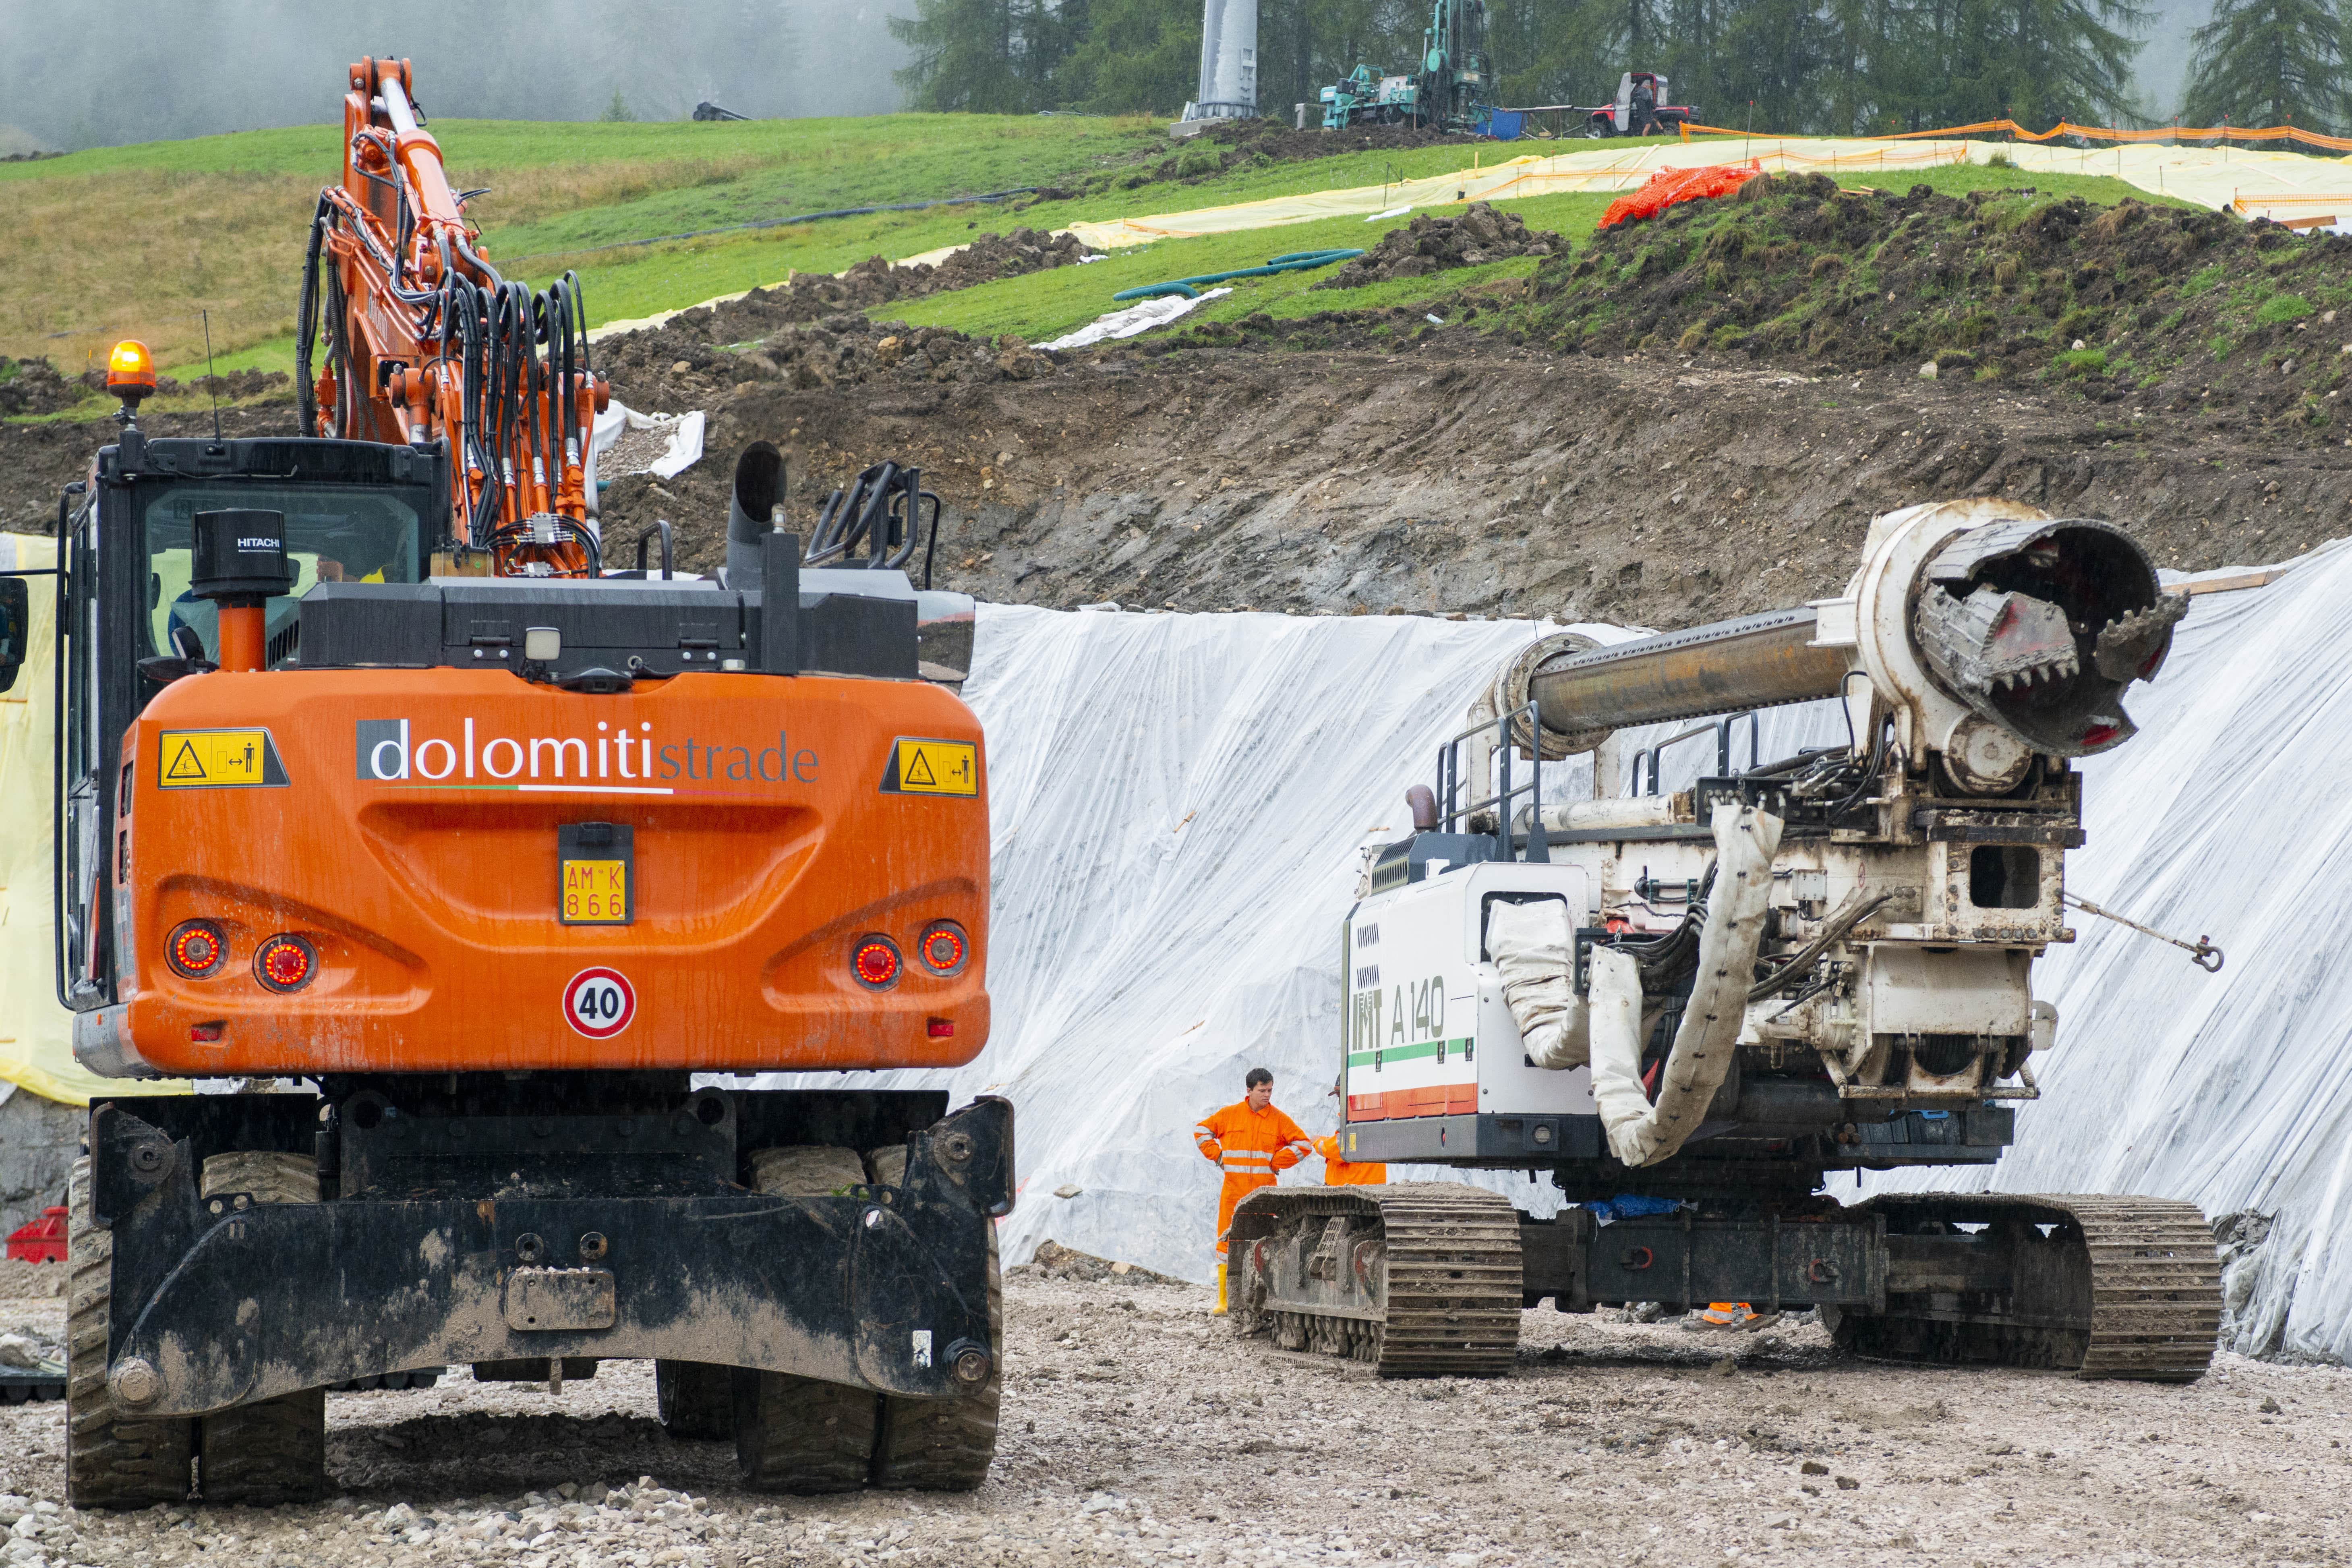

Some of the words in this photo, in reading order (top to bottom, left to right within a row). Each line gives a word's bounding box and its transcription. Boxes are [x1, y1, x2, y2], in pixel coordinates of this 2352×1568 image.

[237, 538, 280, 547] HITACHI
[567, 866, 592, 889] AM
[610, 866, 621, 889] K
[567, 893, 621, 916] 866
[579, 987, 619, 1019] 40
[1391, 985, 1404, 1045] A
[1411, 976, 1444, 1042] 140
